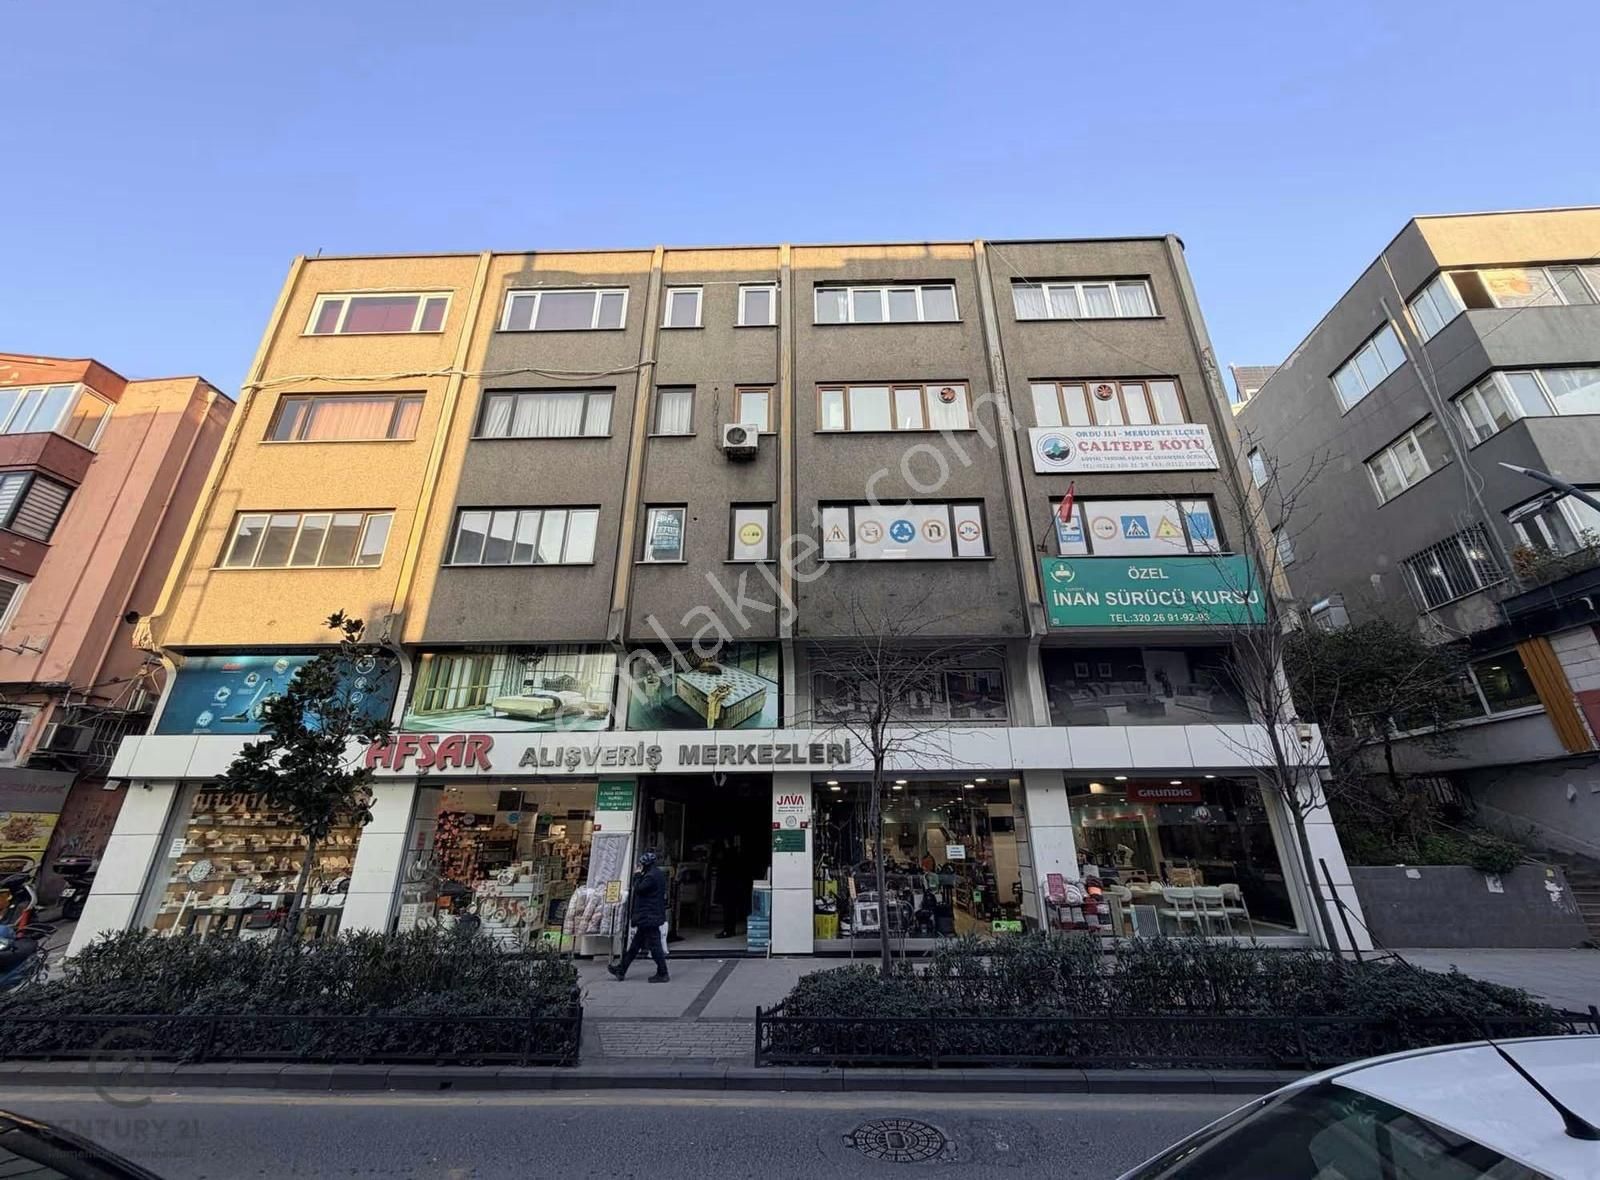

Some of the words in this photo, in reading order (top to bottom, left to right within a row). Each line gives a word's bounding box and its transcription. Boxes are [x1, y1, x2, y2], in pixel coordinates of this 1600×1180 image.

[1075, 430, 1101, 438] ORDU
[1078, 440, 1155, 454] ÇALTEPE
[1159, 437, 1206, 451] KÖYÜ
[1127, 566, 1170, 580] ÖZEL
[1053, 589, 1100, 606] İNAN
[1105, 588, 1186, 606] SÜRÜCÜ
[1191, 589, 1260, 605] KURSU
[1109, 613, 1151, 623] TEL:320
[1153, 613, 1166, 622] 26
[365, 733, 495, 775] AFŞAR
[518, 740, 664, 772] ALIŞVERİŞ
[678, 738, 852, 766] MERKEZLERİ
[1138, 788, 1193, 798] GRUNDIG
[776, 795, 805, 806] JAVA
